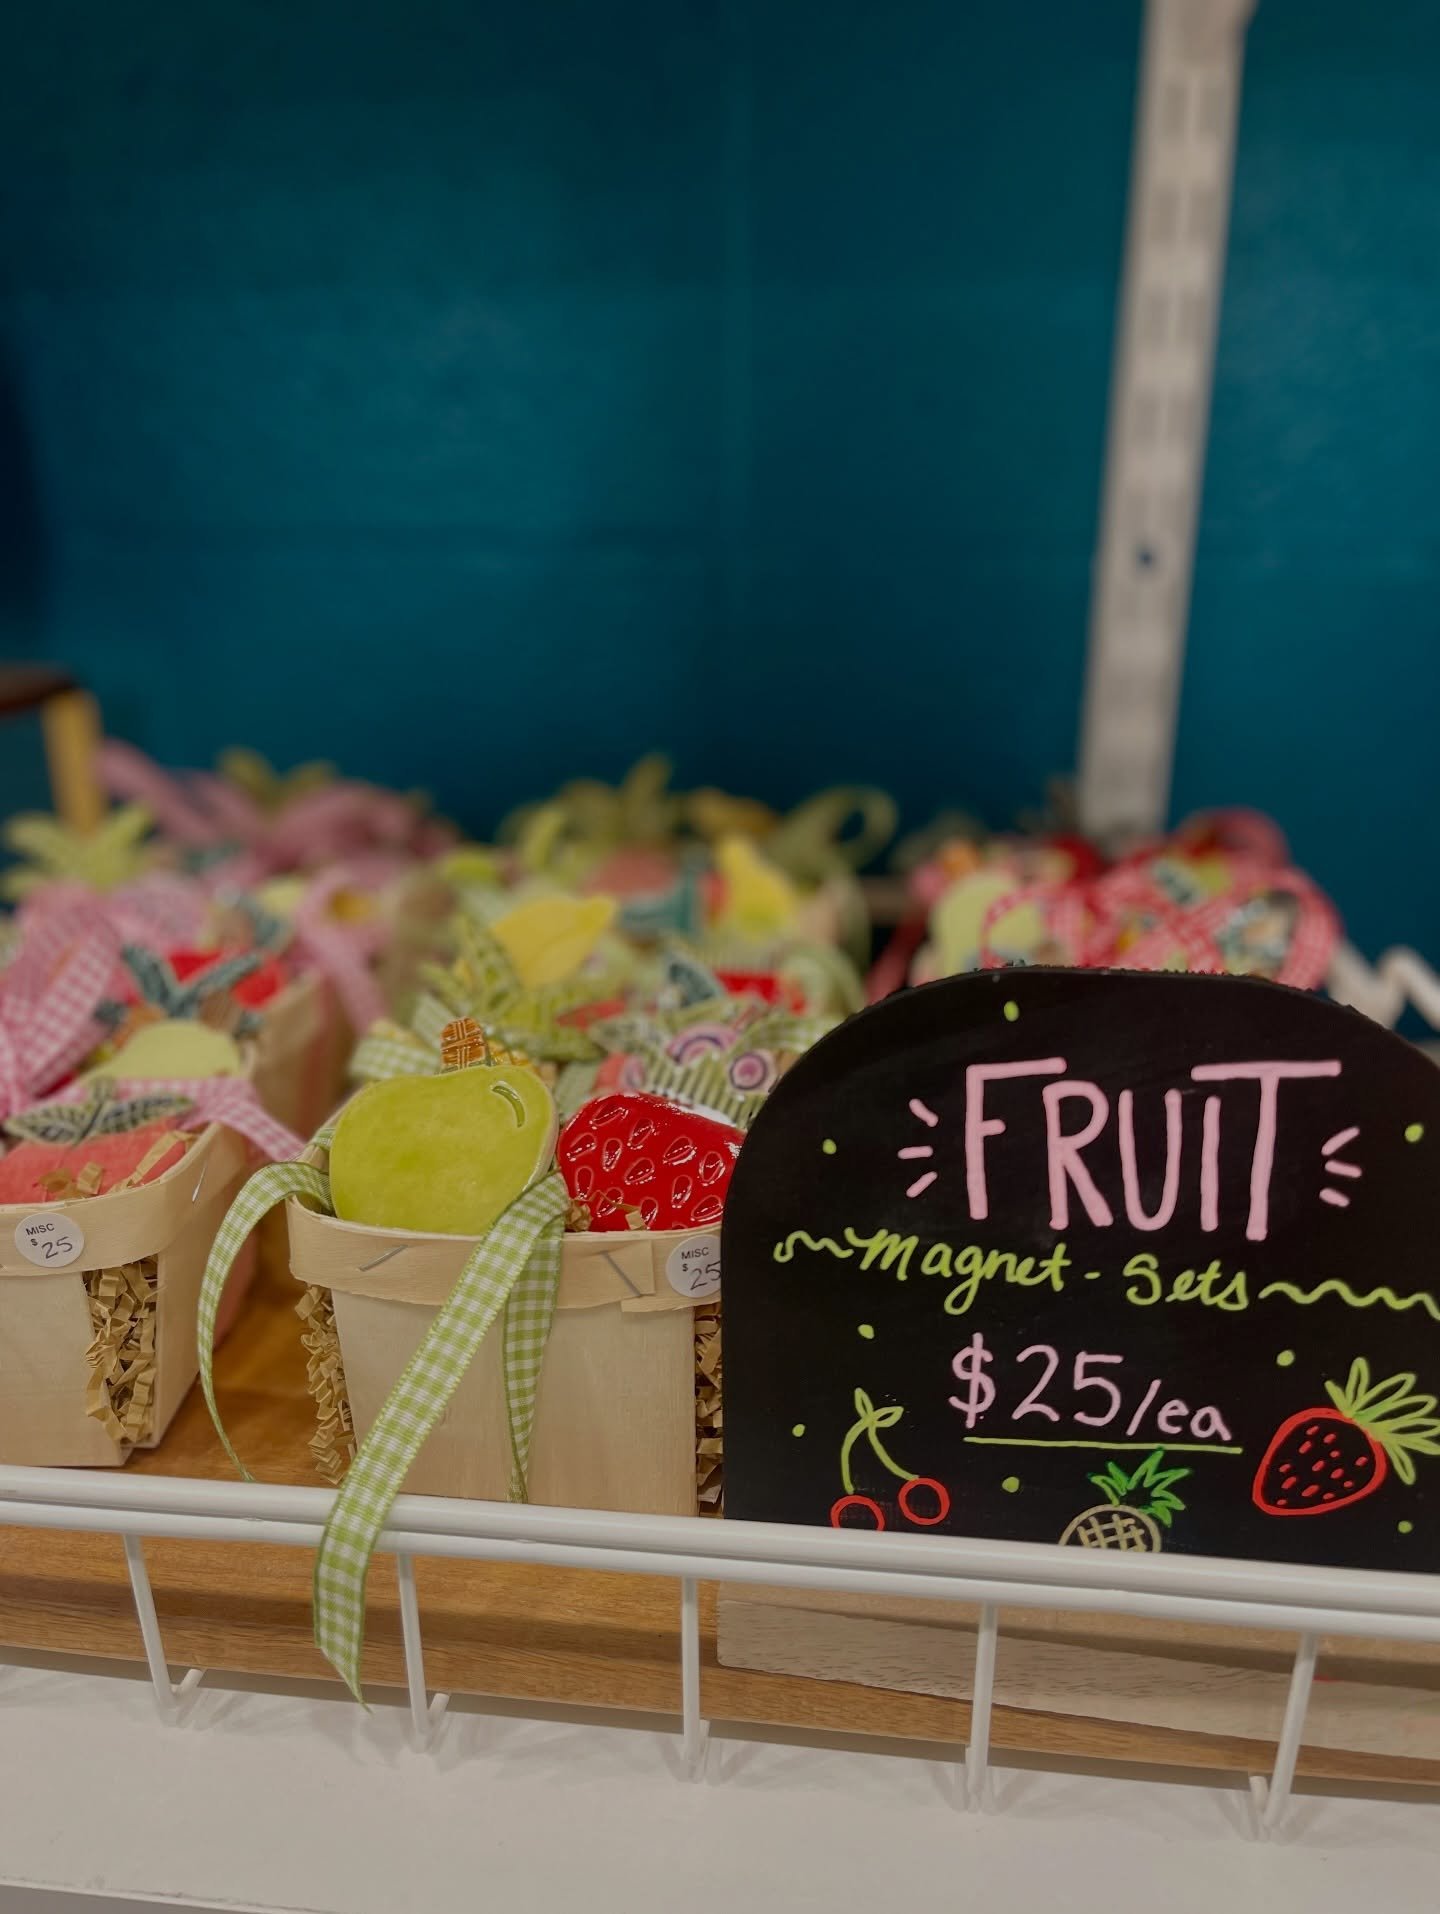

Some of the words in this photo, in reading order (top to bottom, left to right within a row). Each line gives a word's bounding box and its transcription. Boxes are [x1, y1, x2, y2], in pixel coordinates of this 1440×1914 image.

[965, 1057, 1342, 1241] FRUIT
[26, 1223, 55, 1236] MISC
[681, 1247, 710, 1260] MISC
[1123, 1253, 1249, 1311] Sets
[949, 1333, 1233, 1442] $25/ea
